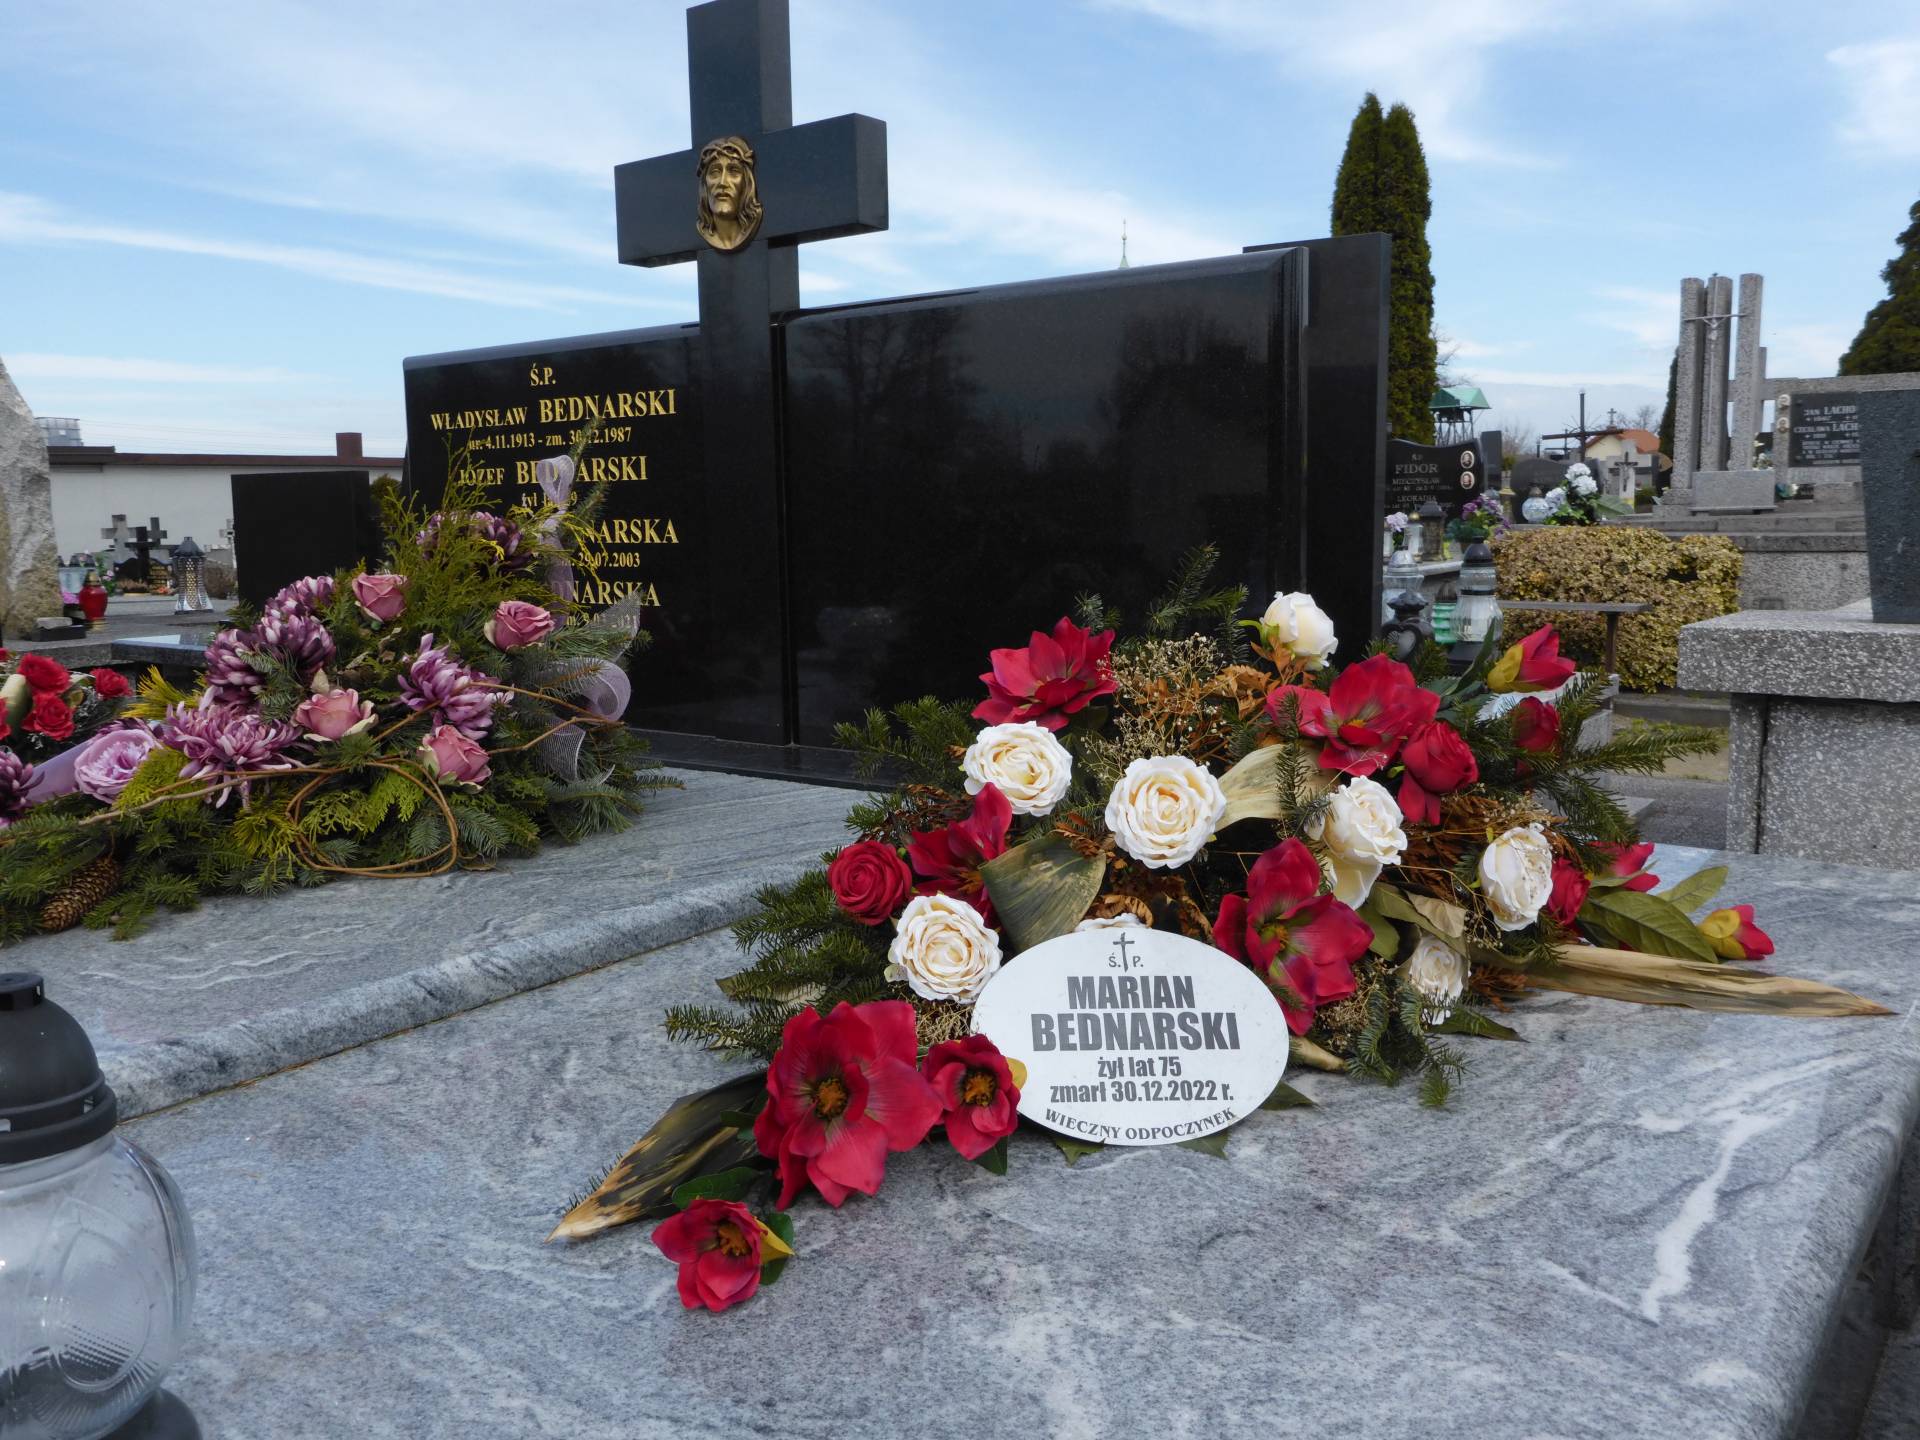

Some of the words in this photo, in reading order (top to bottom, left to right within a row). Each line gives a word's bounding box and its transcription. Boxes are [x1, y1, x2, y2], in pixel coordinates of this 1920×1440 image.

[529, 363, 557, 386] Ś.P.
[430, 406, 528, 431] WŁADYSŁAW
[539, 388, 677, 424] BEDNARSKI
[546, 433, 566, 446] zm.
[569, 426, 632, 445] 302.1987
[1395, 463, 1438, 474] FIDOR
[1067, 975, 1196, 1010] MARIAN
[1031, 1012, 1241, 1052] BEDNARSKI
[1098, 1057, 1125, 1079] żył
[1129, 1057, 1157, 1077] lat
[1159, 1056, 1182, 1077] 75
[1050, 1081, 1107, 1103] zmarł
[1111, 1080, 1218, 1102] 30.12.2022
[1222, 1083, 1234, 1101] r.
[1045, 1108, 1121, 1139] WIECZNY
[1125, 1106, 1237, 1140] ODPOCZYNEK
